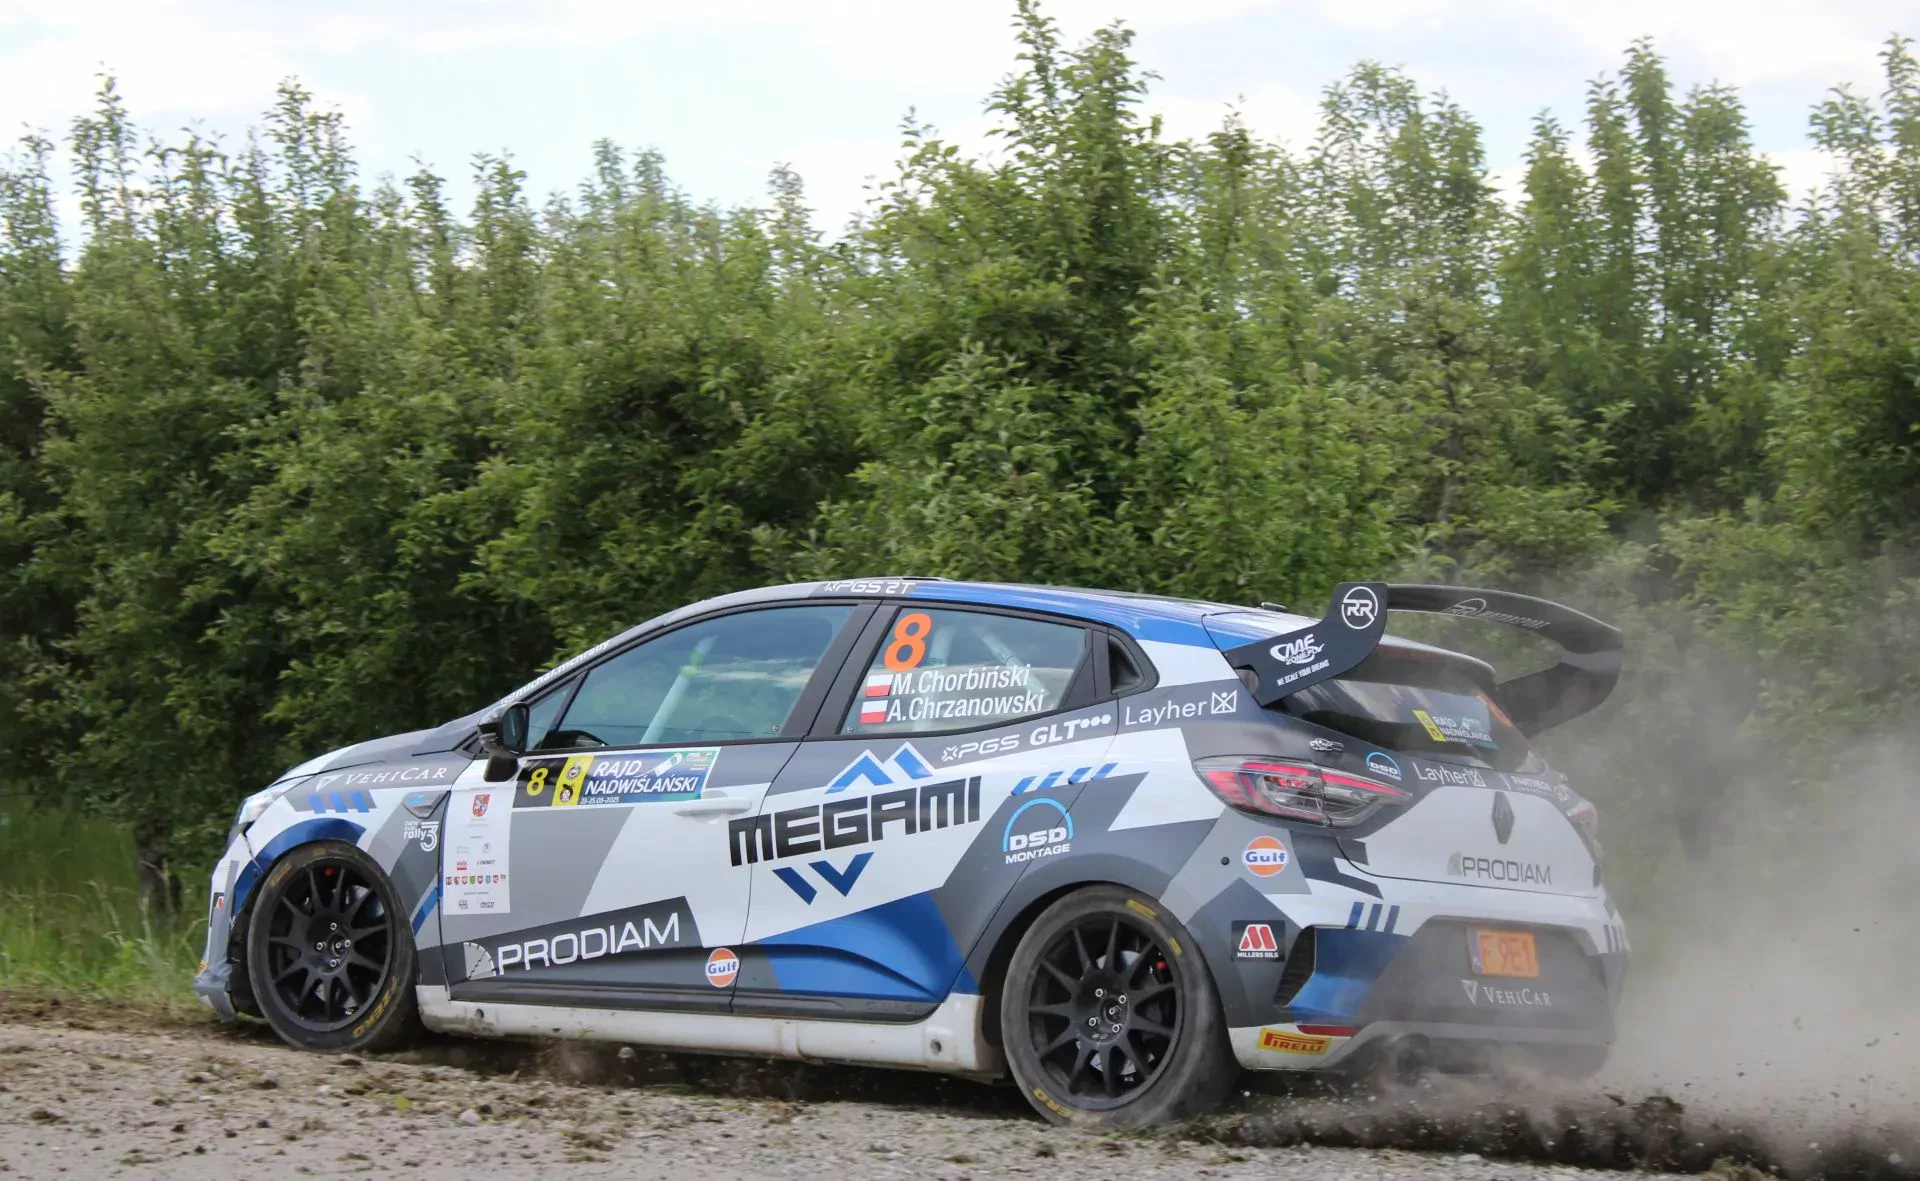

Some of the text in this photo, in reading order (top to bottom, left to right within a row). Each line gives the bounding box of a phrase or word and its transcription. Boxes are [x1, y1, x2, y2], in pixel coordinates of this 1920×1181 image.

[1343, 599, 1375, 621] RR
[884, 613, 933, 672] 8
[891, 663, 1031, 696] M.Chorbiński
[1285, 672, 1299, 684] SCALE
[1299, 667, 1312, 678] YOUR
[886, 689, 1045, 722] A.Chrzanowski
[1125, 700, 1207, 726] Layher
[593, 760, 642, 779] RAJD
[1412, 762, 1469, 785] Layher
[526, 767, 549, 796] 8
[585, 774, 699, 796] NADWIŚLAŃSKI
[728, 775, 982, 867] MEGAMI
[1009, 827, 1067, 851] DSD
[1005, 843, 1071, 865] MONTAGE
[1245, 851, 1286, 863] Gulf
[1463, 856, 1552, 886] PRODIAM
[497, 912, 680, 976] PRODIAM
[1237, 951, 1280, 959] MILLERS OILS
[708, 961, 737, 974] Gulf
[1263, 1031, 1326, 1052] PIRELLI
